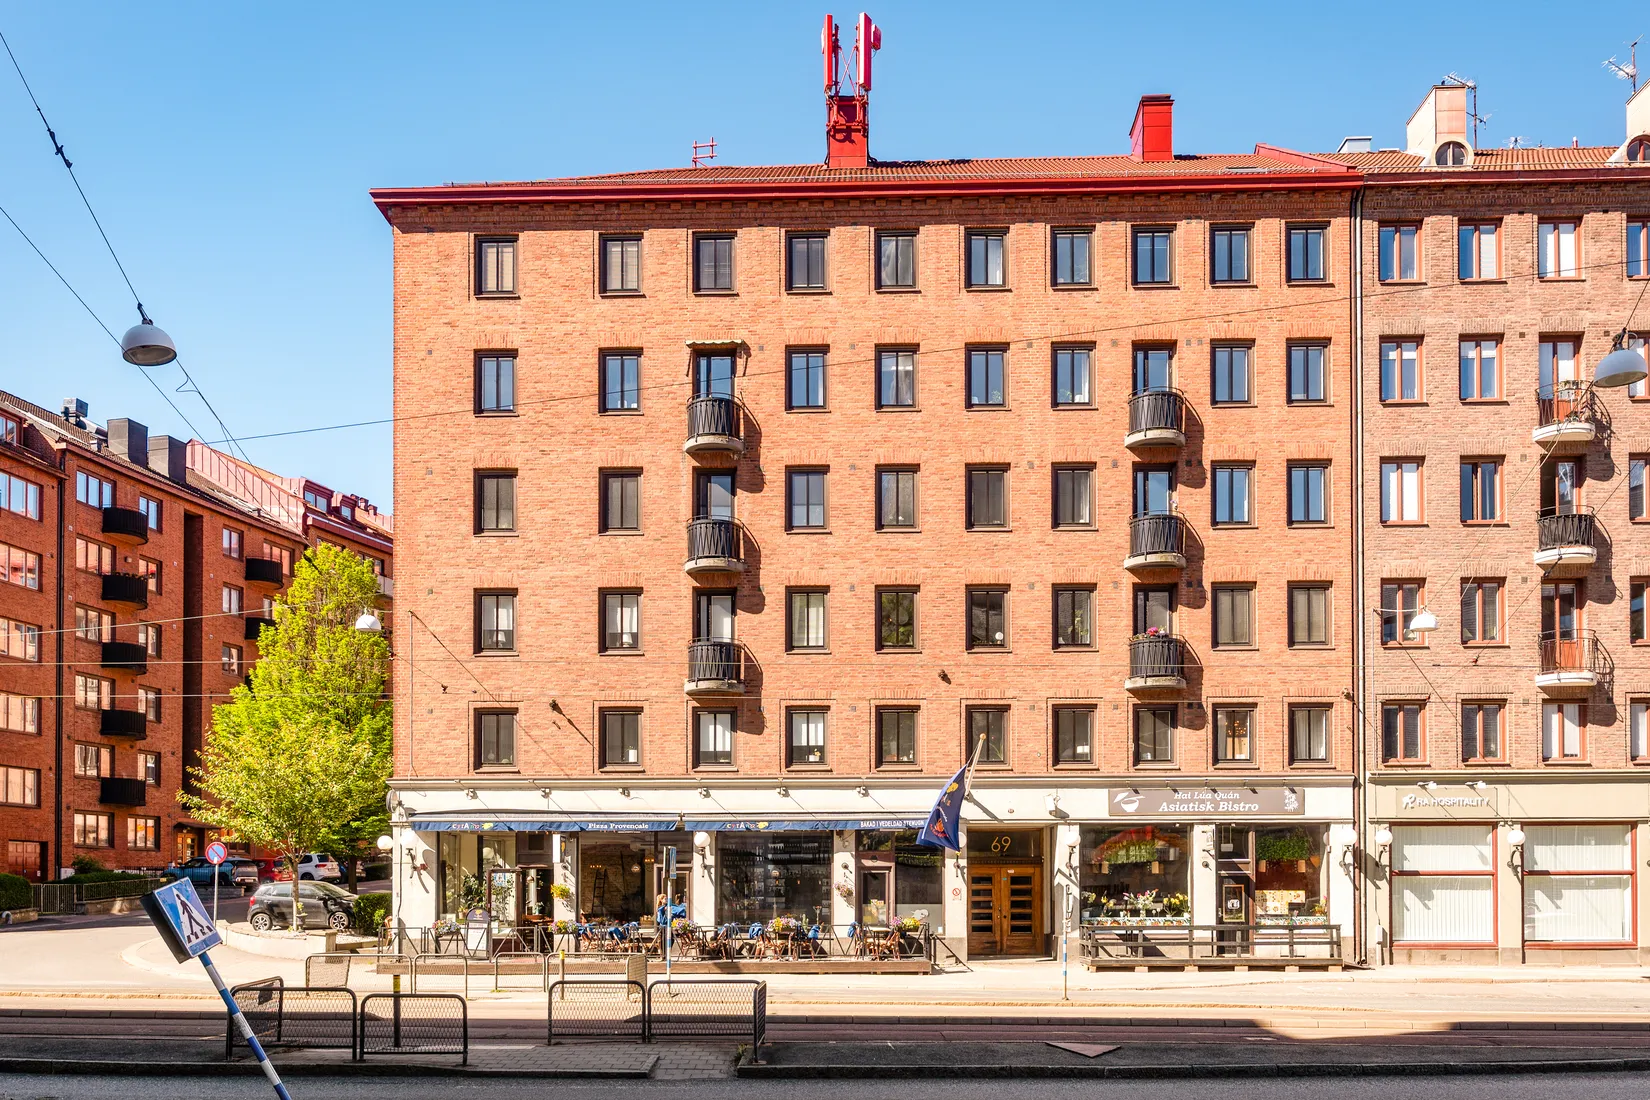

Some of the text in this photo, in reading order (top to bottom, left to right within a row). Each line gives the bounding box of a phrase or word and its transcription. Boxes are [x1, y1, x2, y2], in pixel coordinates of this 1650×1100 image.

[1174, 791, 1240, 801] Hai Lúa Quán
[1158, 801, 1259, 811] Asiatisk Bistro
[1431, 797, 1490, 807] HOSPITALITY
[609, 822, 649, 830] Provençale
[991, 836, 1011, 852] 69
